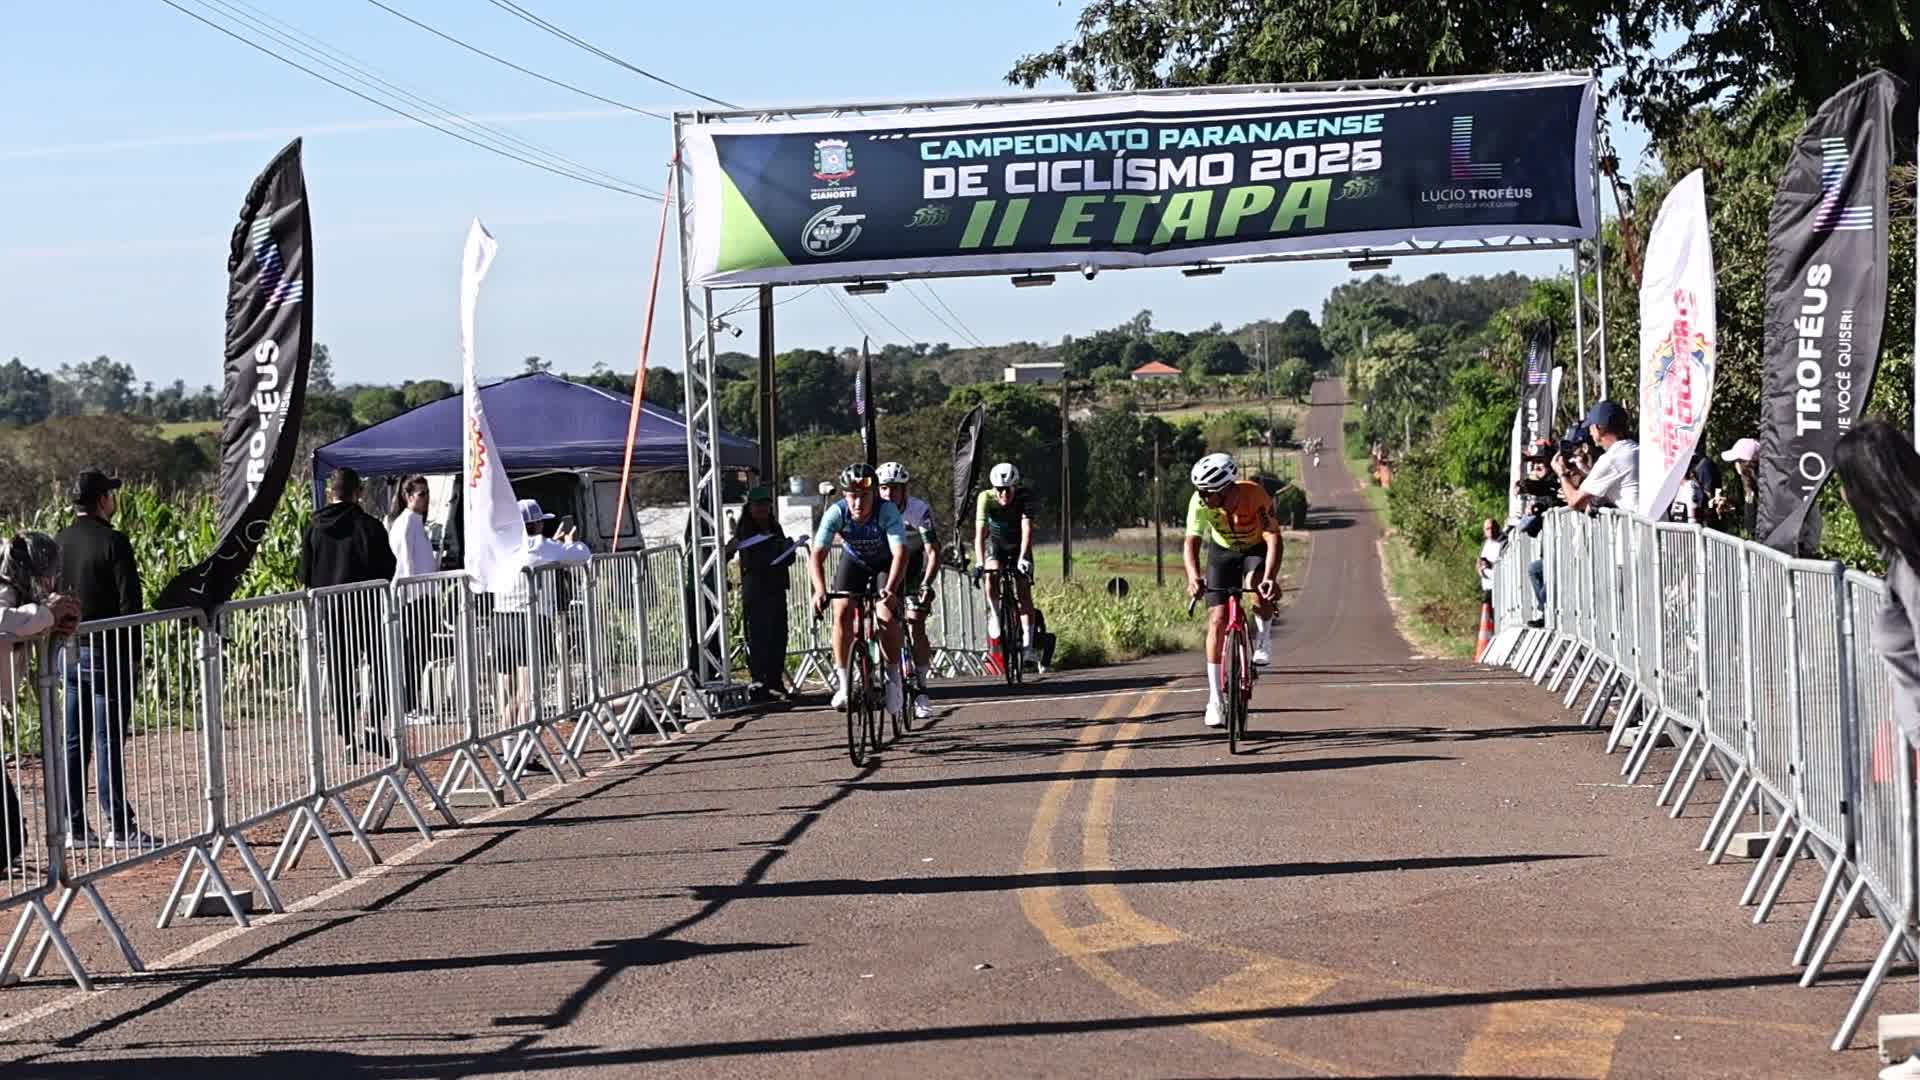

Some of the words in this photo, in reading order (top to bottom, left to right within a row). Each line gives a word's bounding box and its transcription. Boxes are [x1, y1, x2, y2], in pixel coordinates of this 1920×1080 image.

[920, 128, 1149, 160] CAMPEONATO
[1159, 113, 1385, 150] PARANAENSE
[923, 165, 989, 199] DE
[1005, 149, 1235, 194] CICLÍSMO
[1250, 139, 1382, 182] 2025
[810, 190, 857, 200] CIANORTE
[959, 198, 1031, 248] II
[1050, 179, 1333, 245] ETAPA
[1421, 188, 1466, 202] LUCIO
[1469, 186, 1533, 200] TROFÉUS
[1794, 263, 1832, 436] TROFÉUS
[1835, 371, 1851, 413] VOCÊ
